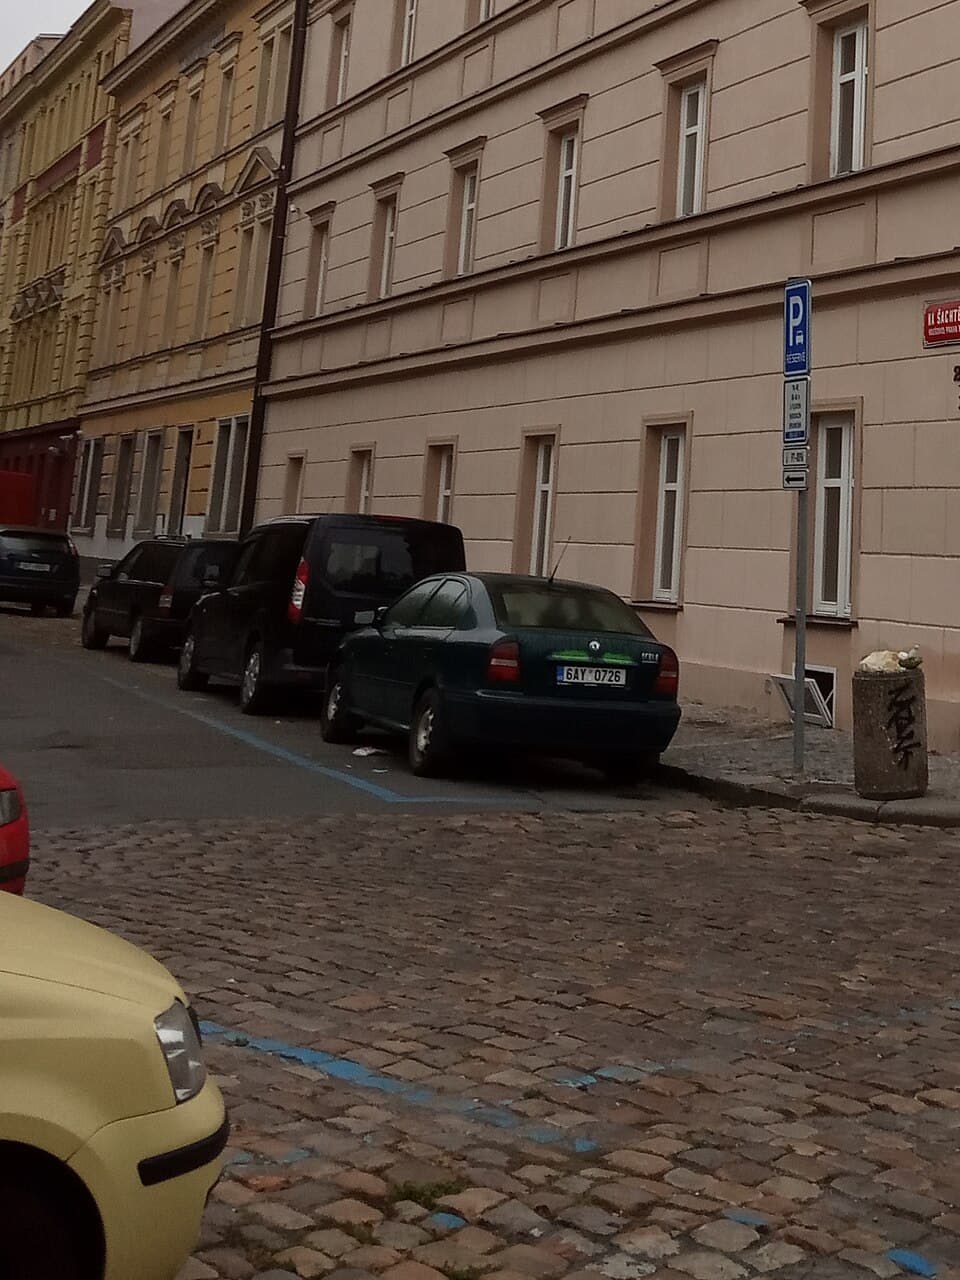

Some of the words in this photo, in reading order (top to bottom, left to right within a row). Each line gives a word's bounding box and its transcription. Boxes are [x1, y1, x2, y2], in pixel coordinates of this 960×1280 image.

[789, 295, 803, 347] P
[566, 668, 587, 681] 6AY
[594, 669, 621, 682] 0726
